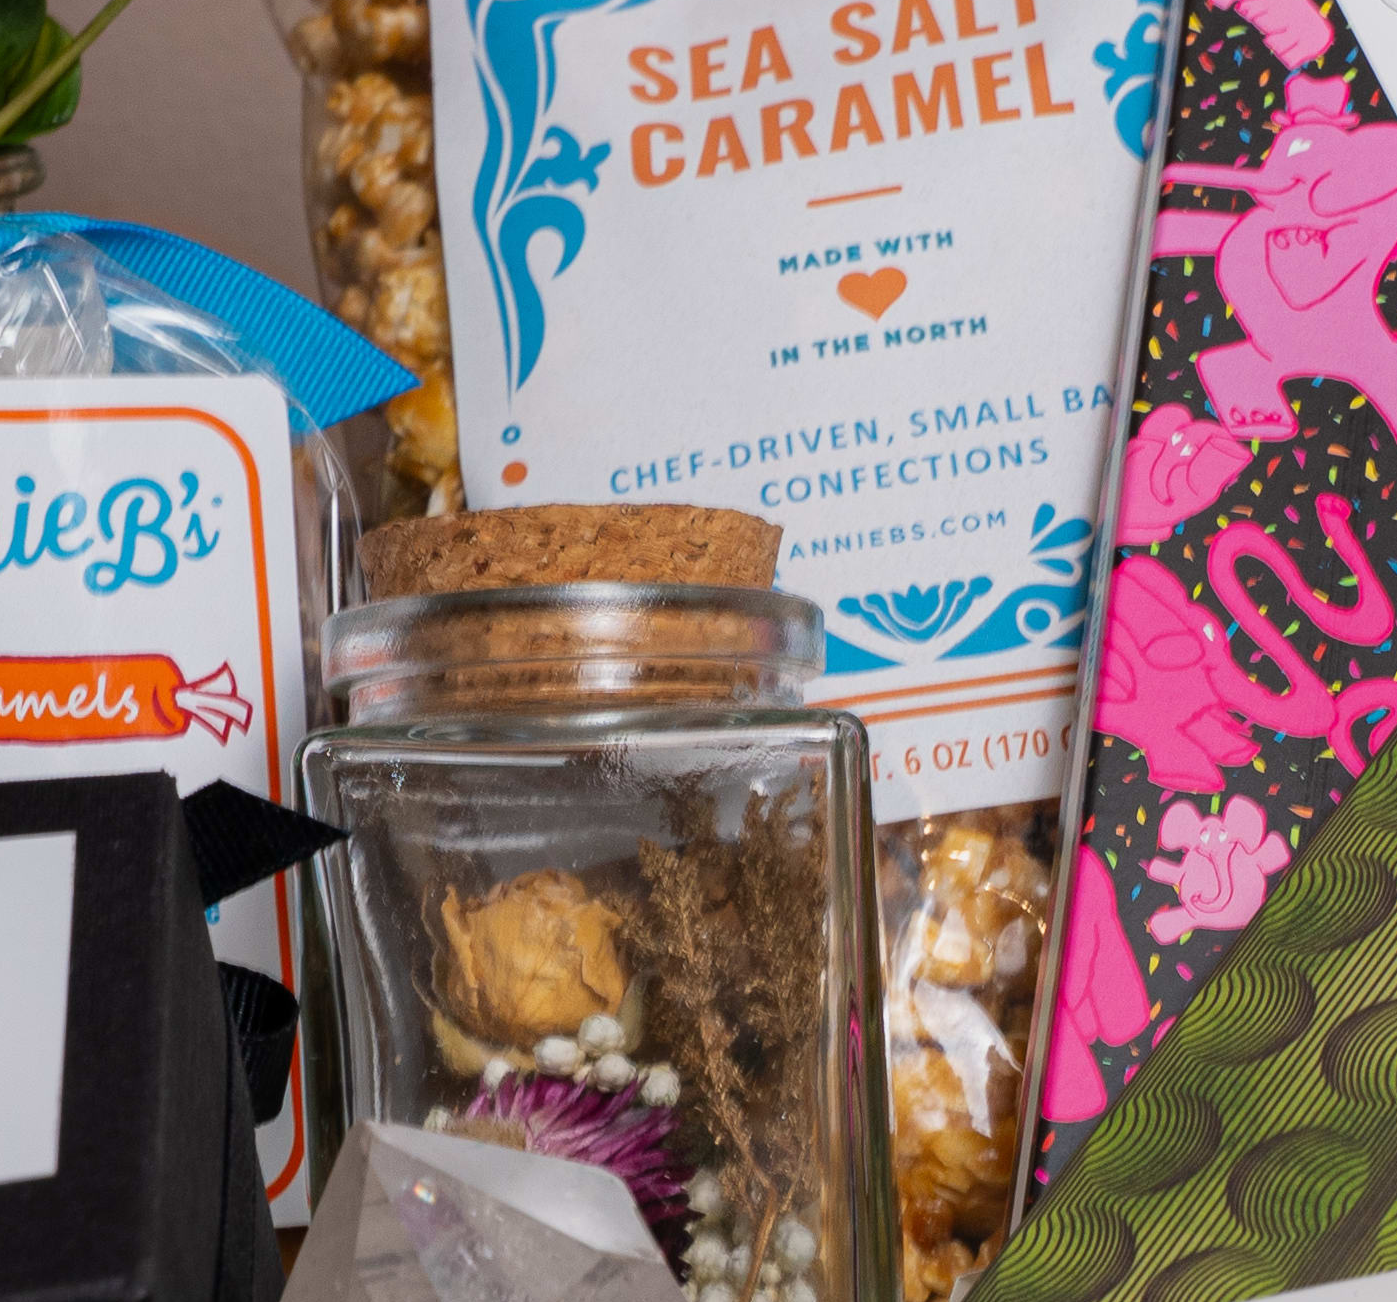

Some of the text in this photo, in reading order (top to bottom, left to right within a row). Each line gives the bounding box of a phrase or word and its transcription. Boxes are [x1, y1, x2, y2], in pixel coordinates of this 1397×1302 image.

[627, 23, 794, 104] SEA
[630, 41, 1075, 188] CARAMEL
[778, 229, 954, 276] MADE WITH
[770, 315, 989, 369] IN THE NORTH
[609, 382, 1117, 496] CHEF-DRIVEN, SMALL BA
[760, 436, 1049, 509] CONFECTIONS
[788, 509, 1007, 563] ANNIEBS.COM
[871, 753, 895, 783] T.
[905, 747, 922, 775] 6
[932, 740, 974, 772] OZ
[983, 727, 1050, 771] (170
